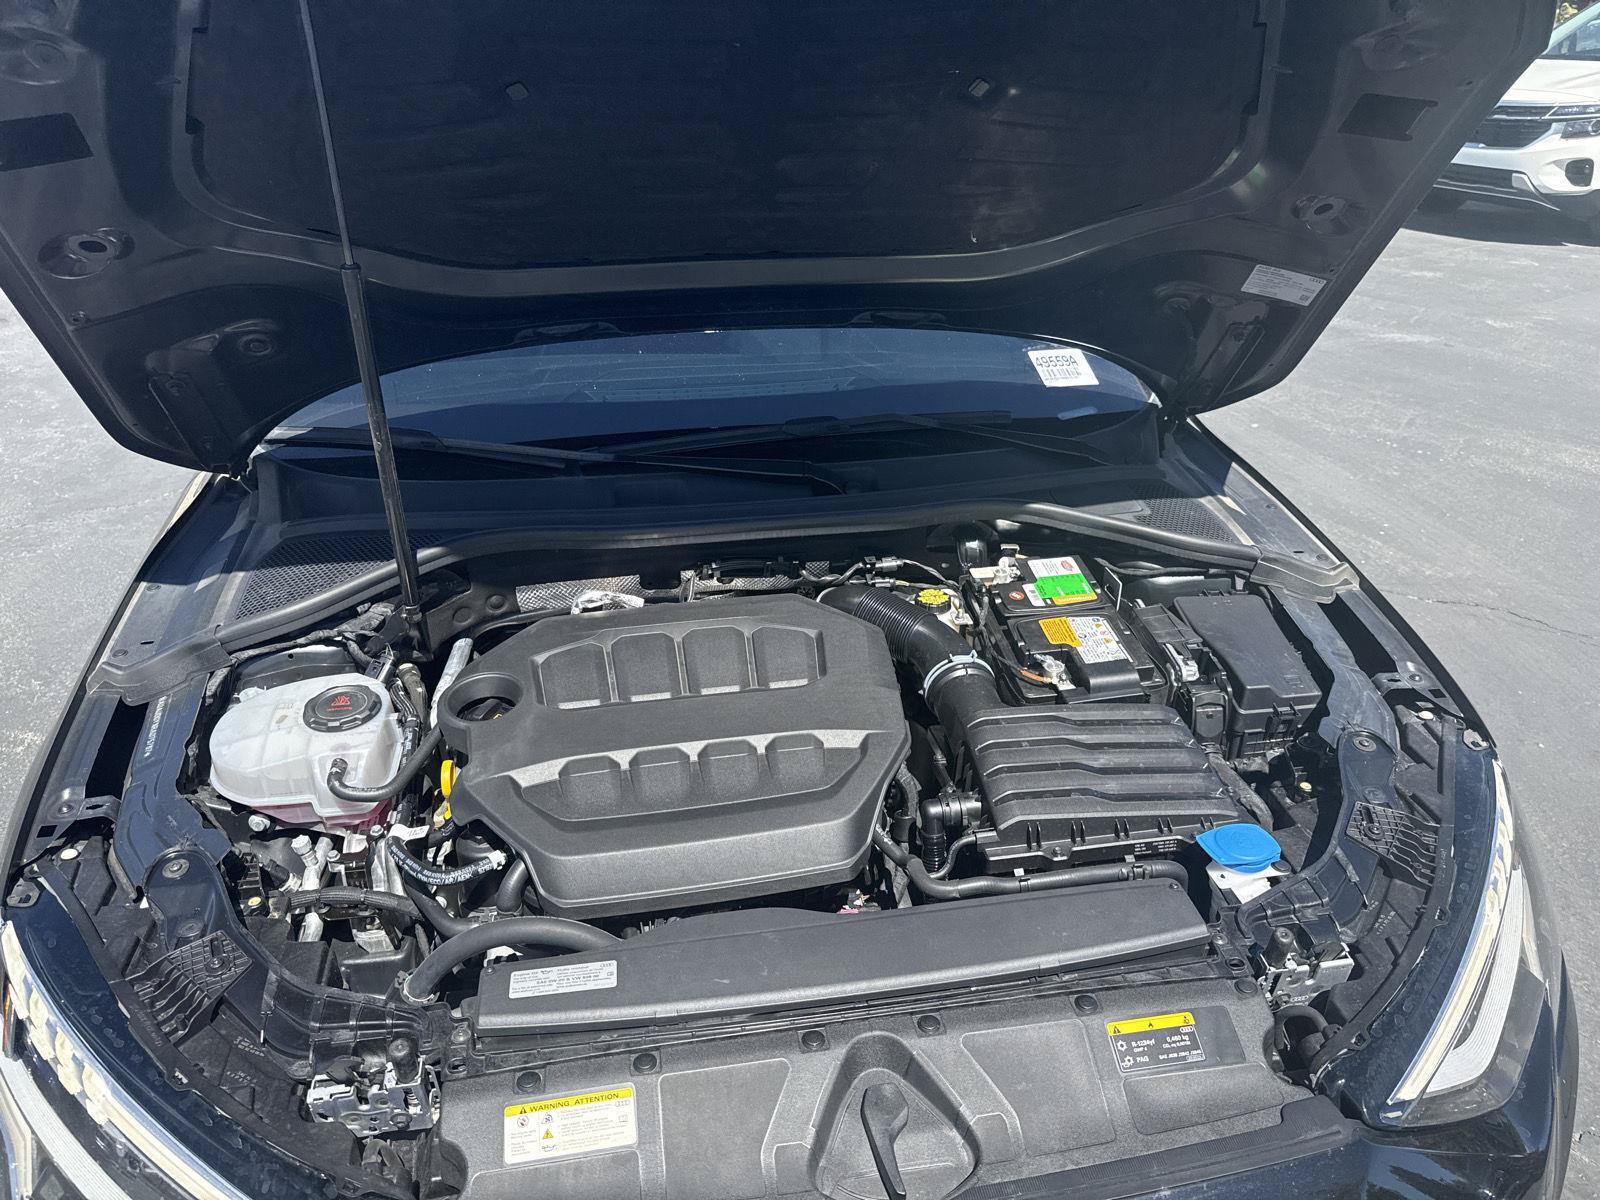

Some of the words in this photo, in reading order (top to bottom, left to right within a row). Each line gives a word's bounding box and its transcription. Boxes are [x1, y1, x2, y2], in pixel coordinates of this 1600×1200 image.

[1035, 354, 1079, 368] 49559A
[529, 1099, 570, 1113] WARNING
[574, 1092, 620, 1106] ATTENTION
